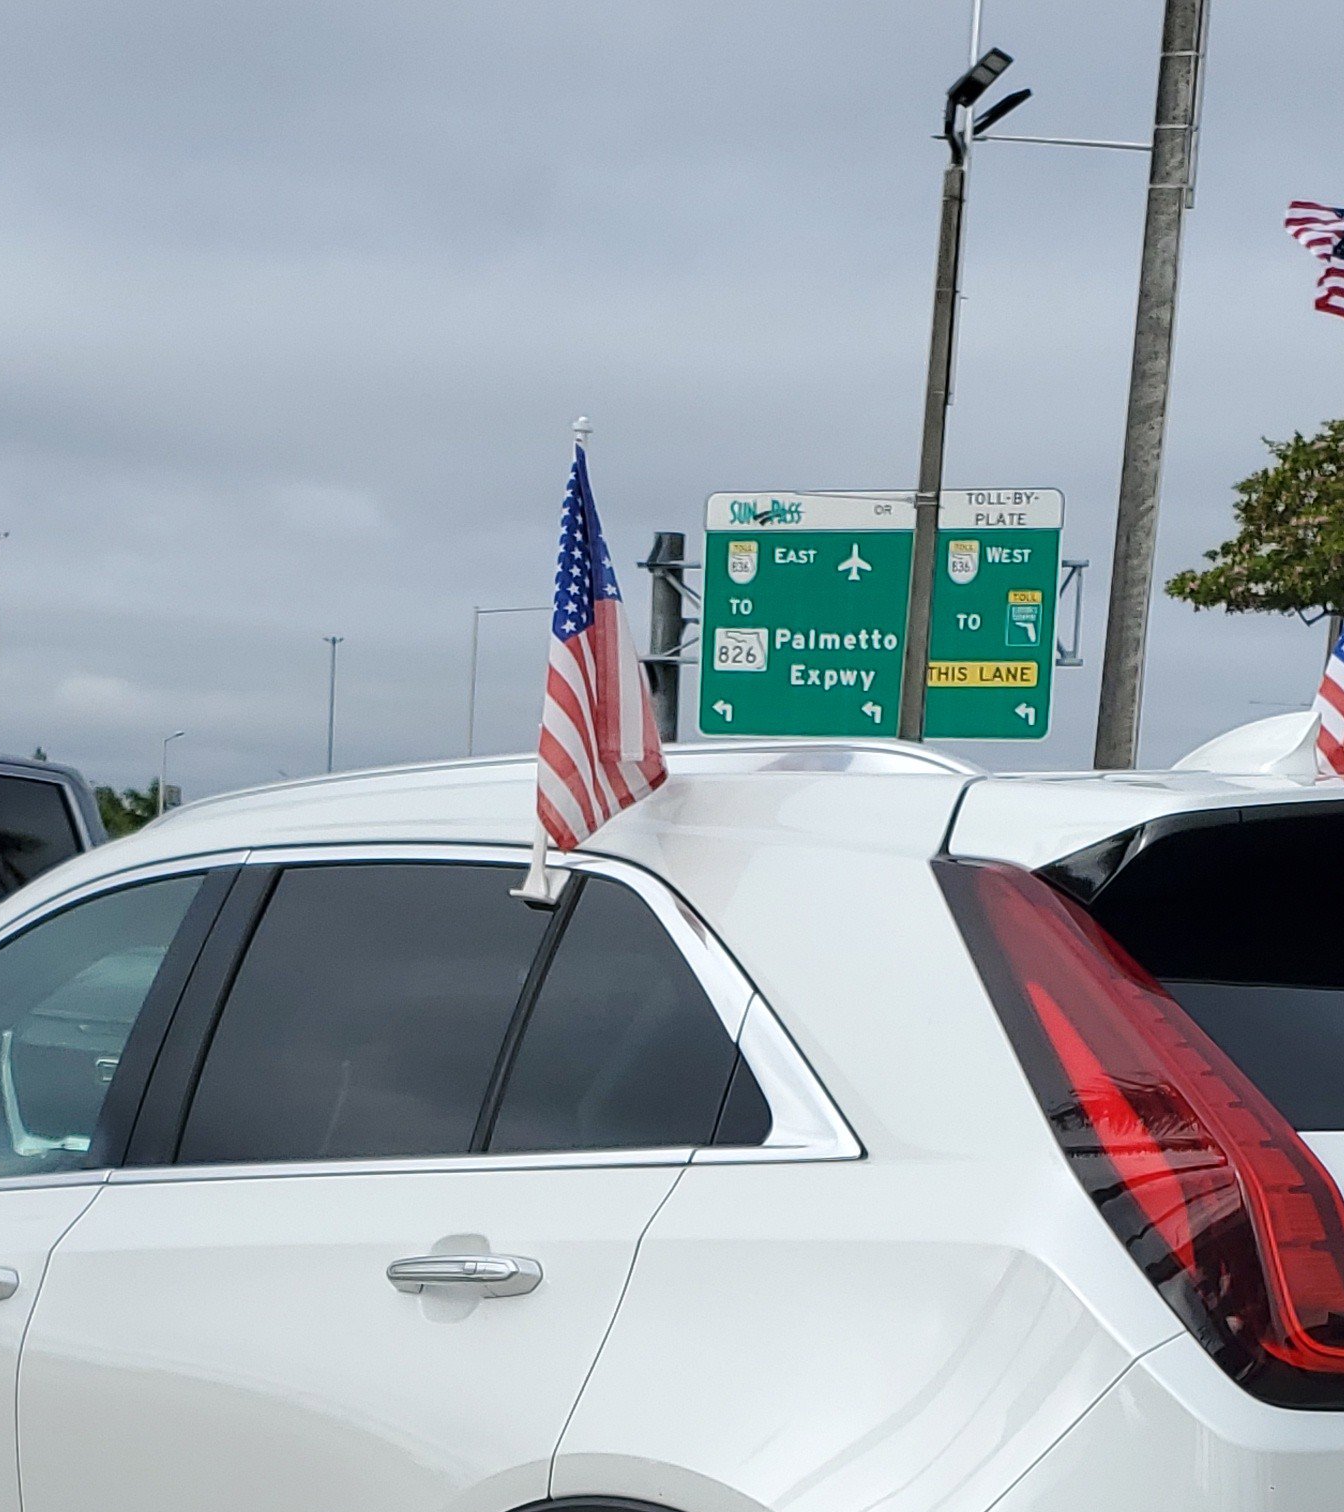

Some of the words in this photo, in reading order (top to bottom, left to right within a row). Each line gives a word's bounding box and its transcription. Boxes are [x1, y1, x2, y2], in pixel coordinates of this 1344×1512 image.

[873, 504, 892, 515] OR
[975, 512, 1027, 526] PLATE
[774, 547, 817, 564] EAST
[986, 547, 1032, 563] WEST
[729, 598, 753, 615] TO
[956, 614, 981, 630] TO
[774, 628, 898, 650] Palmetto
[718, 645, 757, 664] 826
[790, 664, 875, 691] Expwy
[928, 666, 968, 682] THIS
[979, 666, 1032, 682] LANE
